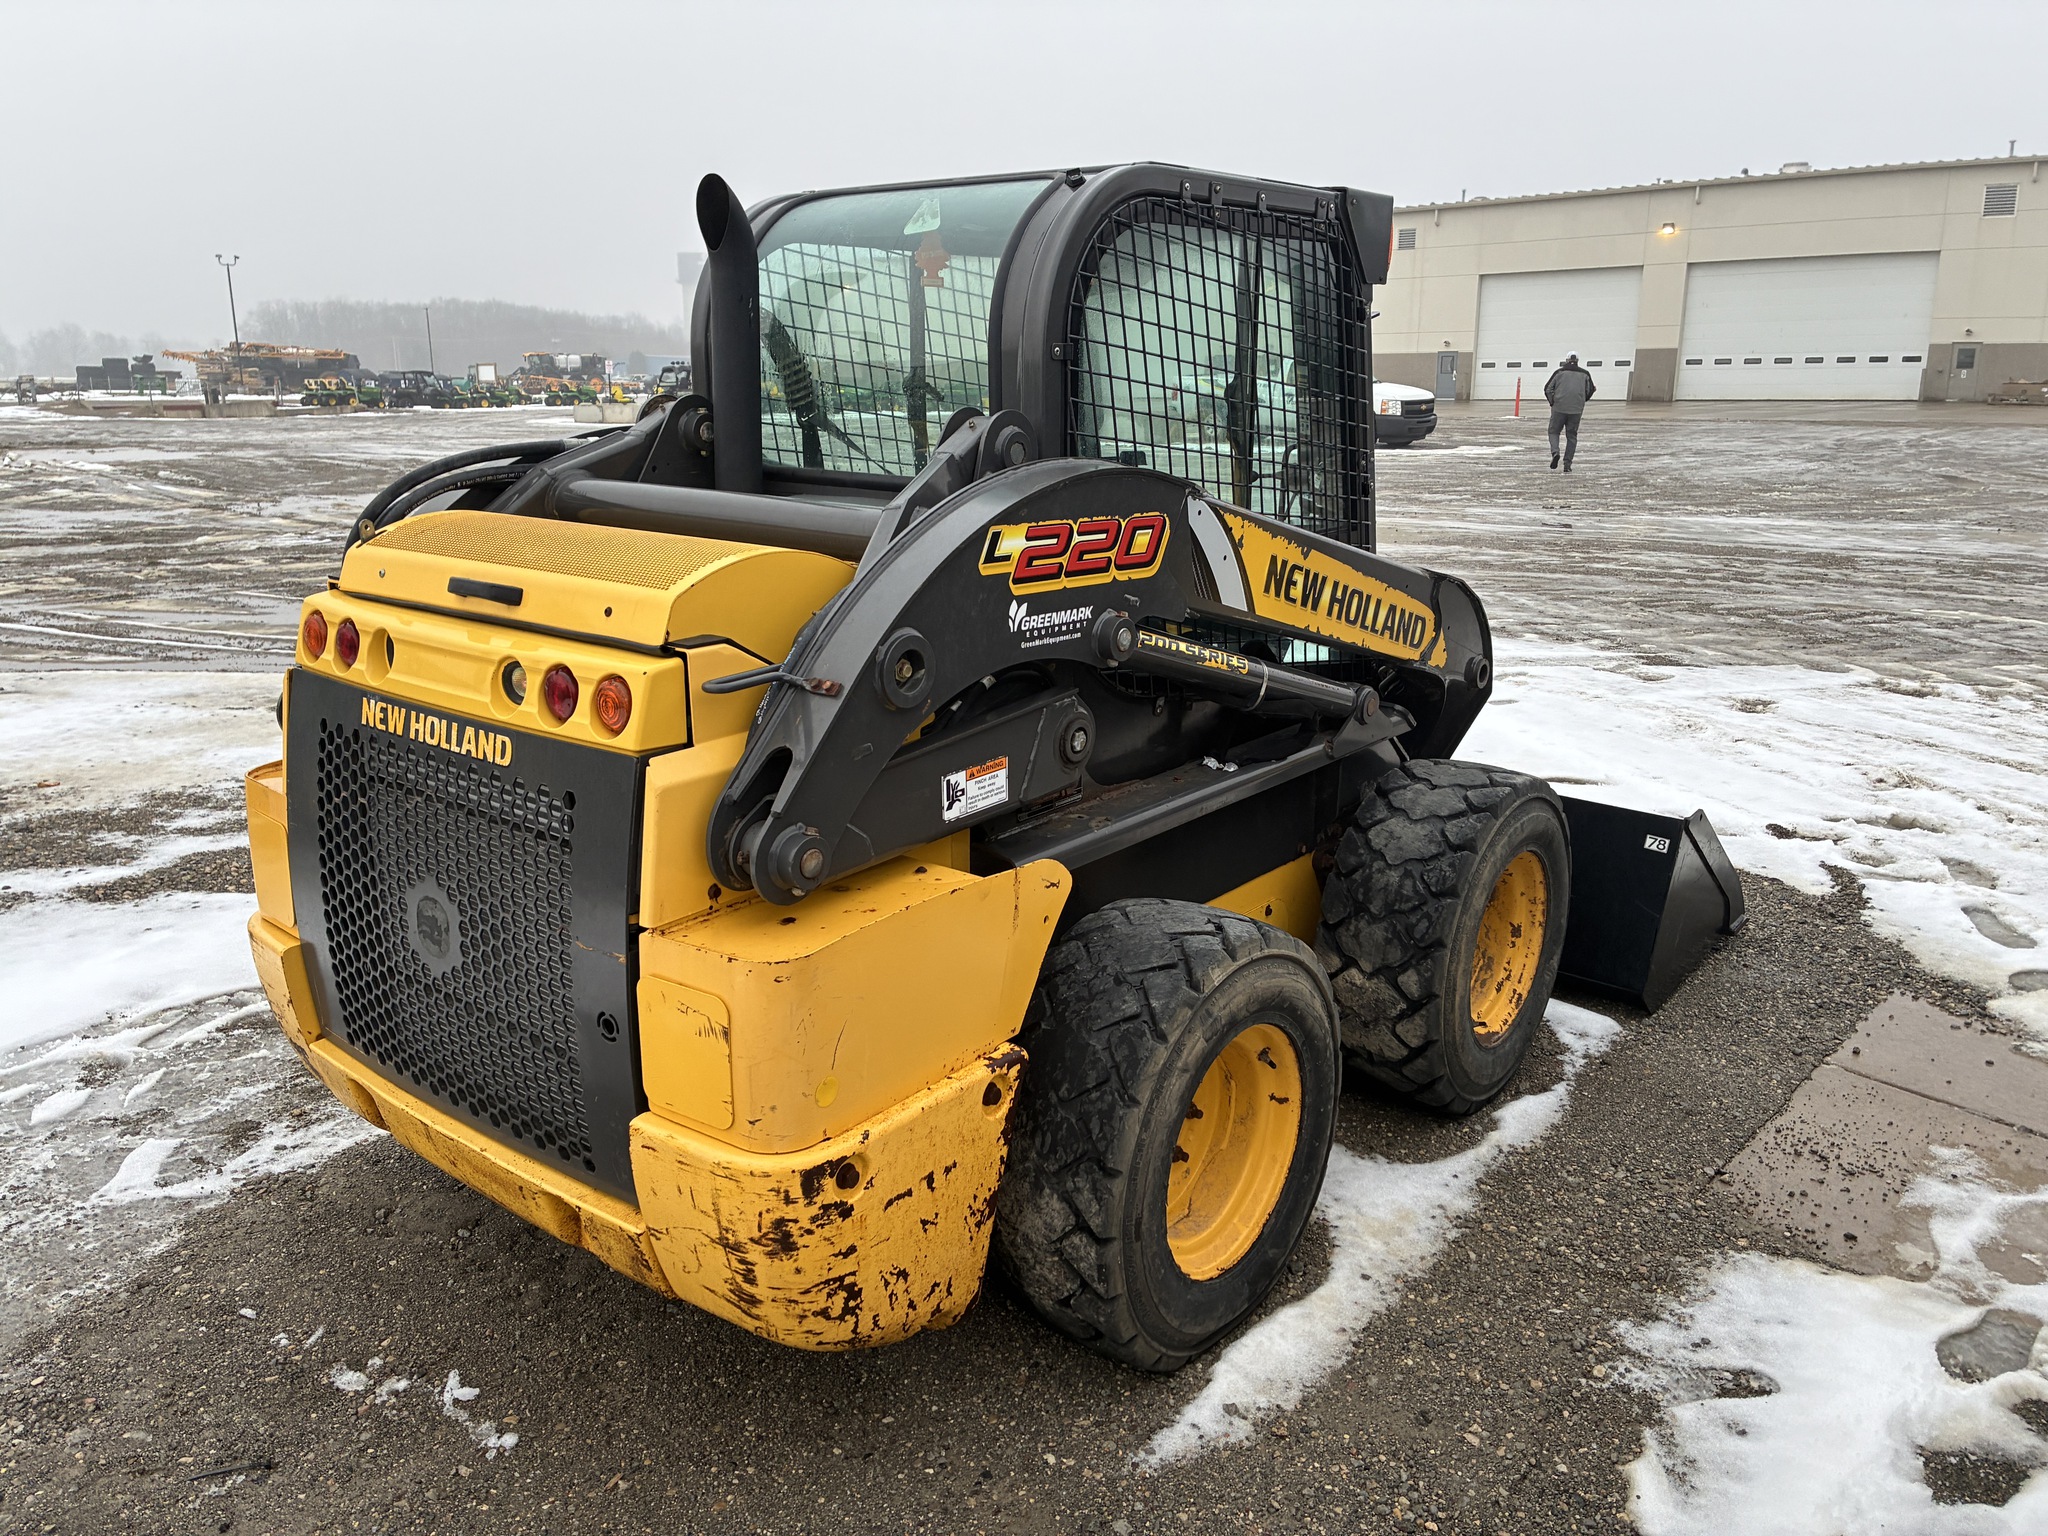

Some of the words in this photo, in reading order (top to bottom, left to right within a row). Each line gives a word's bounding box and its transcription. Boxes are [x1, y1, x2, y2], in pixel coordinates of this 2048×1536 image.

[981, 514, 1168, 588] L220
[1263, 554, 1327, 614] NEW
[1327, 580, 1427, 650] HOLLAND
[1021, 606, 1093, 631] GREENMARK
[1026, 621, 1087, 637] EQUIPMENT
[1021, 632, 1082, 649] GreenMarkEquipment.com
[1185, 644, 1248, 671] SERIES
[361, 697, 406, 736] NEW
[409, 711, 513, 767] HOLLAND
[976, 760, 1004, 774] WARNING
[988, 773, 998, 781] AREA
[1647, 836, 1667, 851] 78
